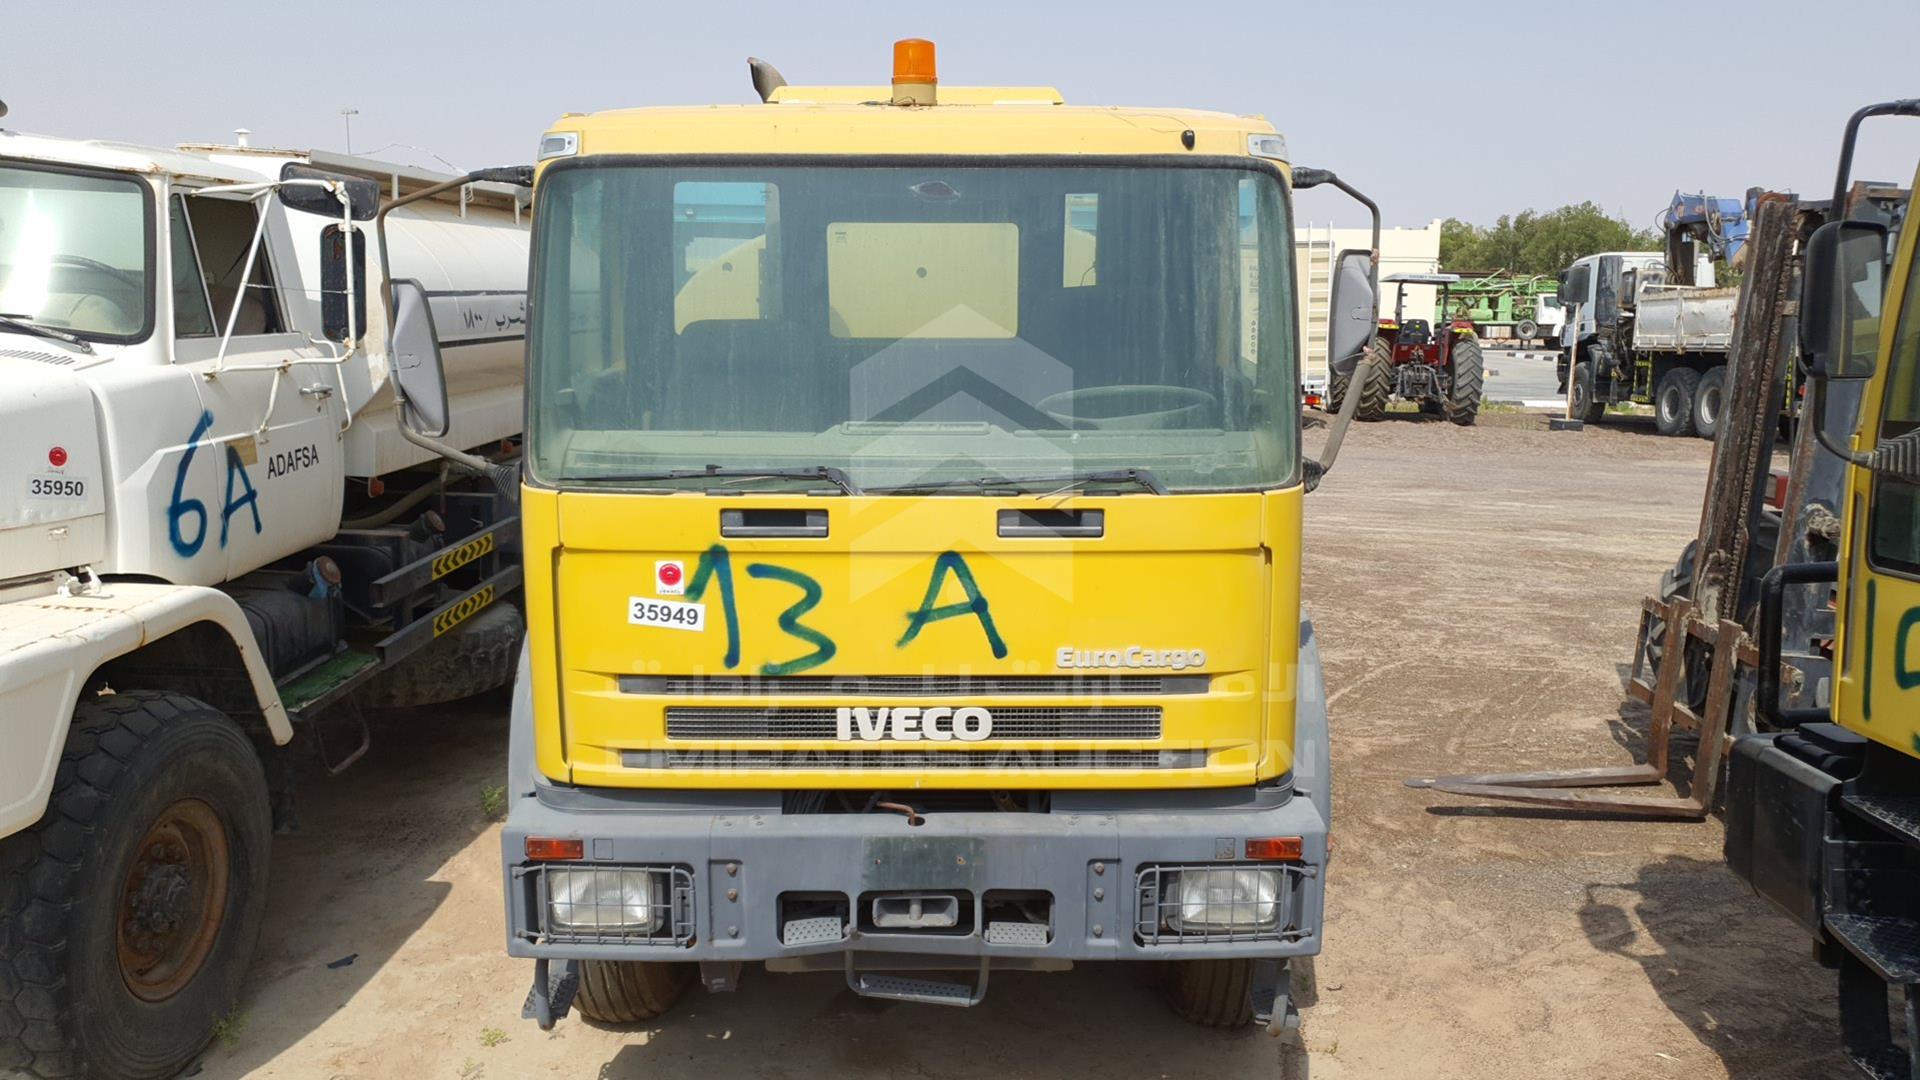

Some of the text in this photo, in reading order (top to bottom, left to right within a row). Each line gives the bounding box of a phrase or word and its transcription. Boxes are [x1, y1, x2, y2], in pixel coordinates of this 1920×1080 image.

[267, 444, 320, 480] ADAFSA
[32, 479, 84, 496] 35950
[633, 602, 699, 626] 35949
[684, 545, 1008, 676] 13 A
[1056, 646, 1207, 670] EuroCargo
[836, 707, 994, 741] IVECO
